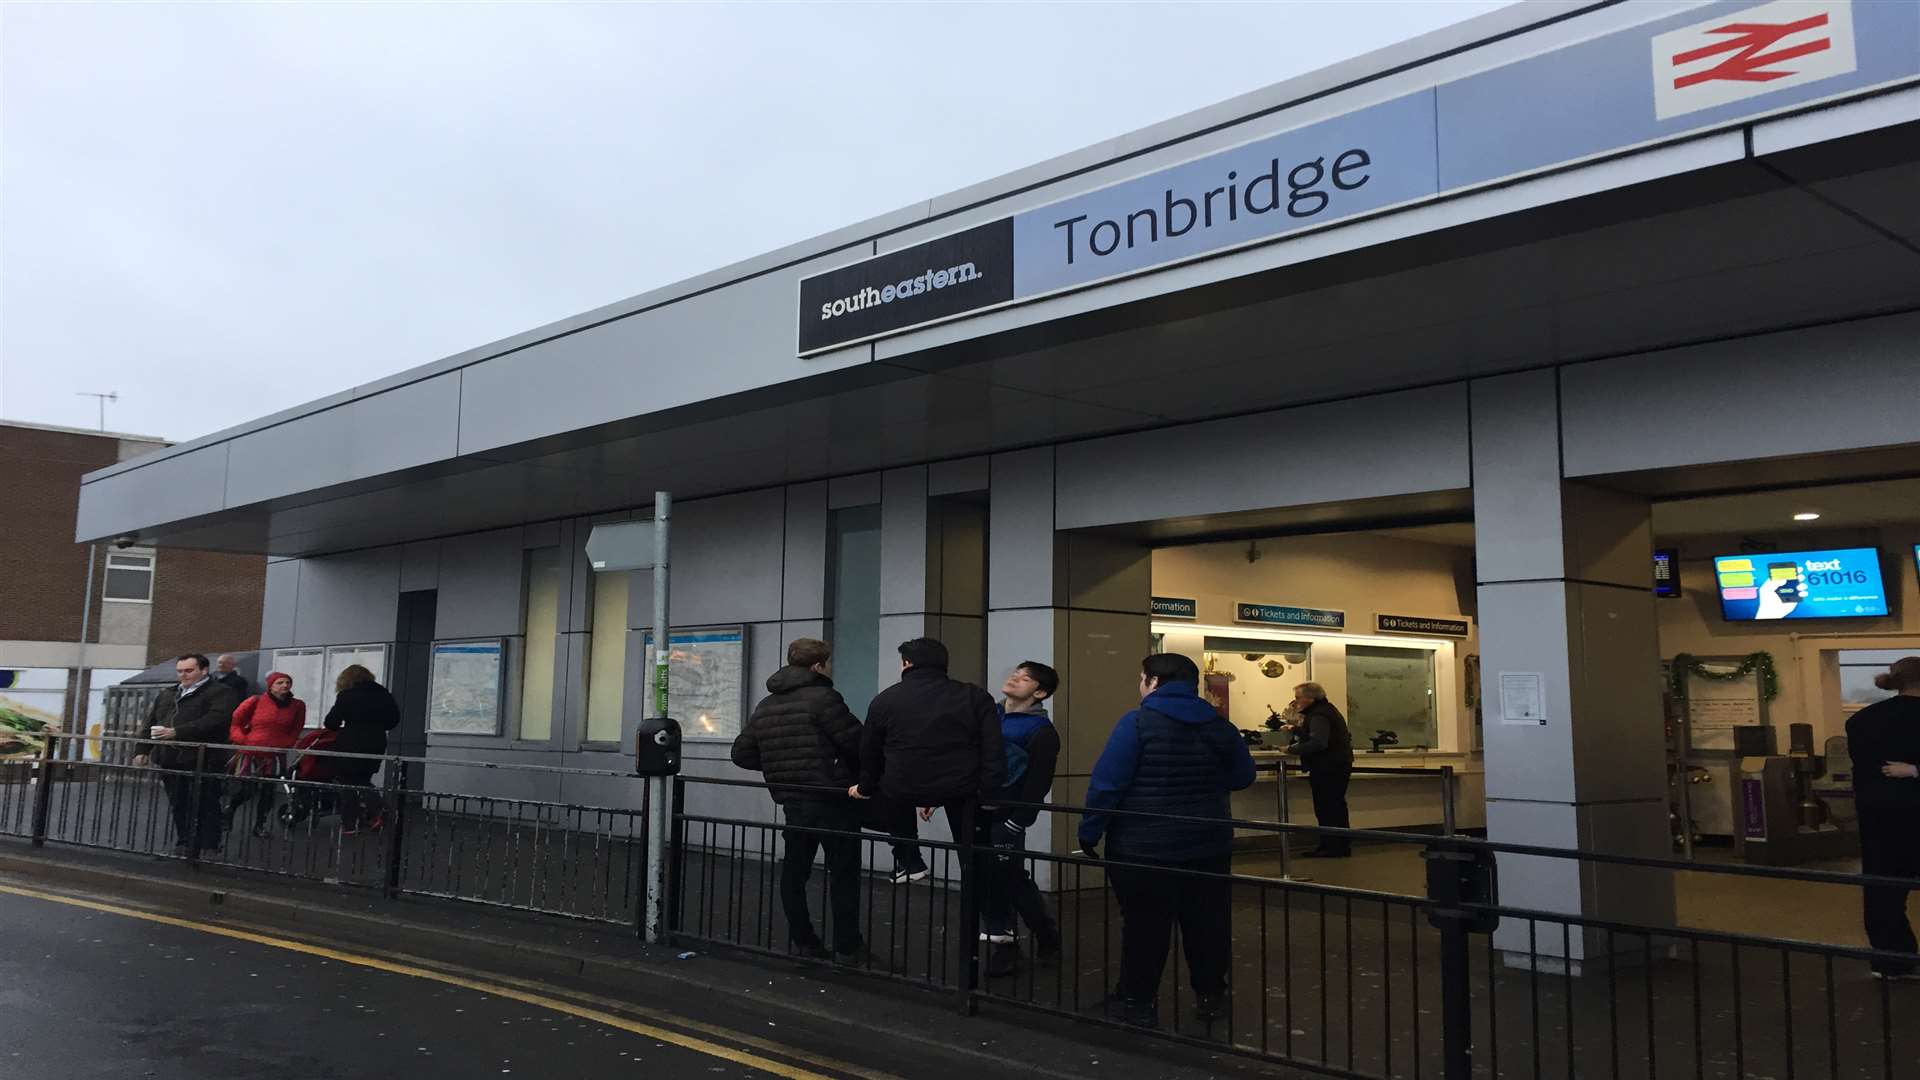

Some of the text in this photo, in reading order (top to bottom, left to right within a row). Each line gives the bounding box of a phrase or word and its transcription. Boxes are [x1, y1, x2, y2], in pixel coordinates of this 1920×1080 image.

[1054, 148, 1371, 264] Tonbridge
[821, 262, 983, 320] southeastern.
[1805, 558, 1841, 571] text
[1808, 570, 1867, 585] 61016
[1259, 608, 1340, 623] Tickets and Information
[1397, 619, 1418, 629] Tickets
[1420, 621, 1431, 631] and
